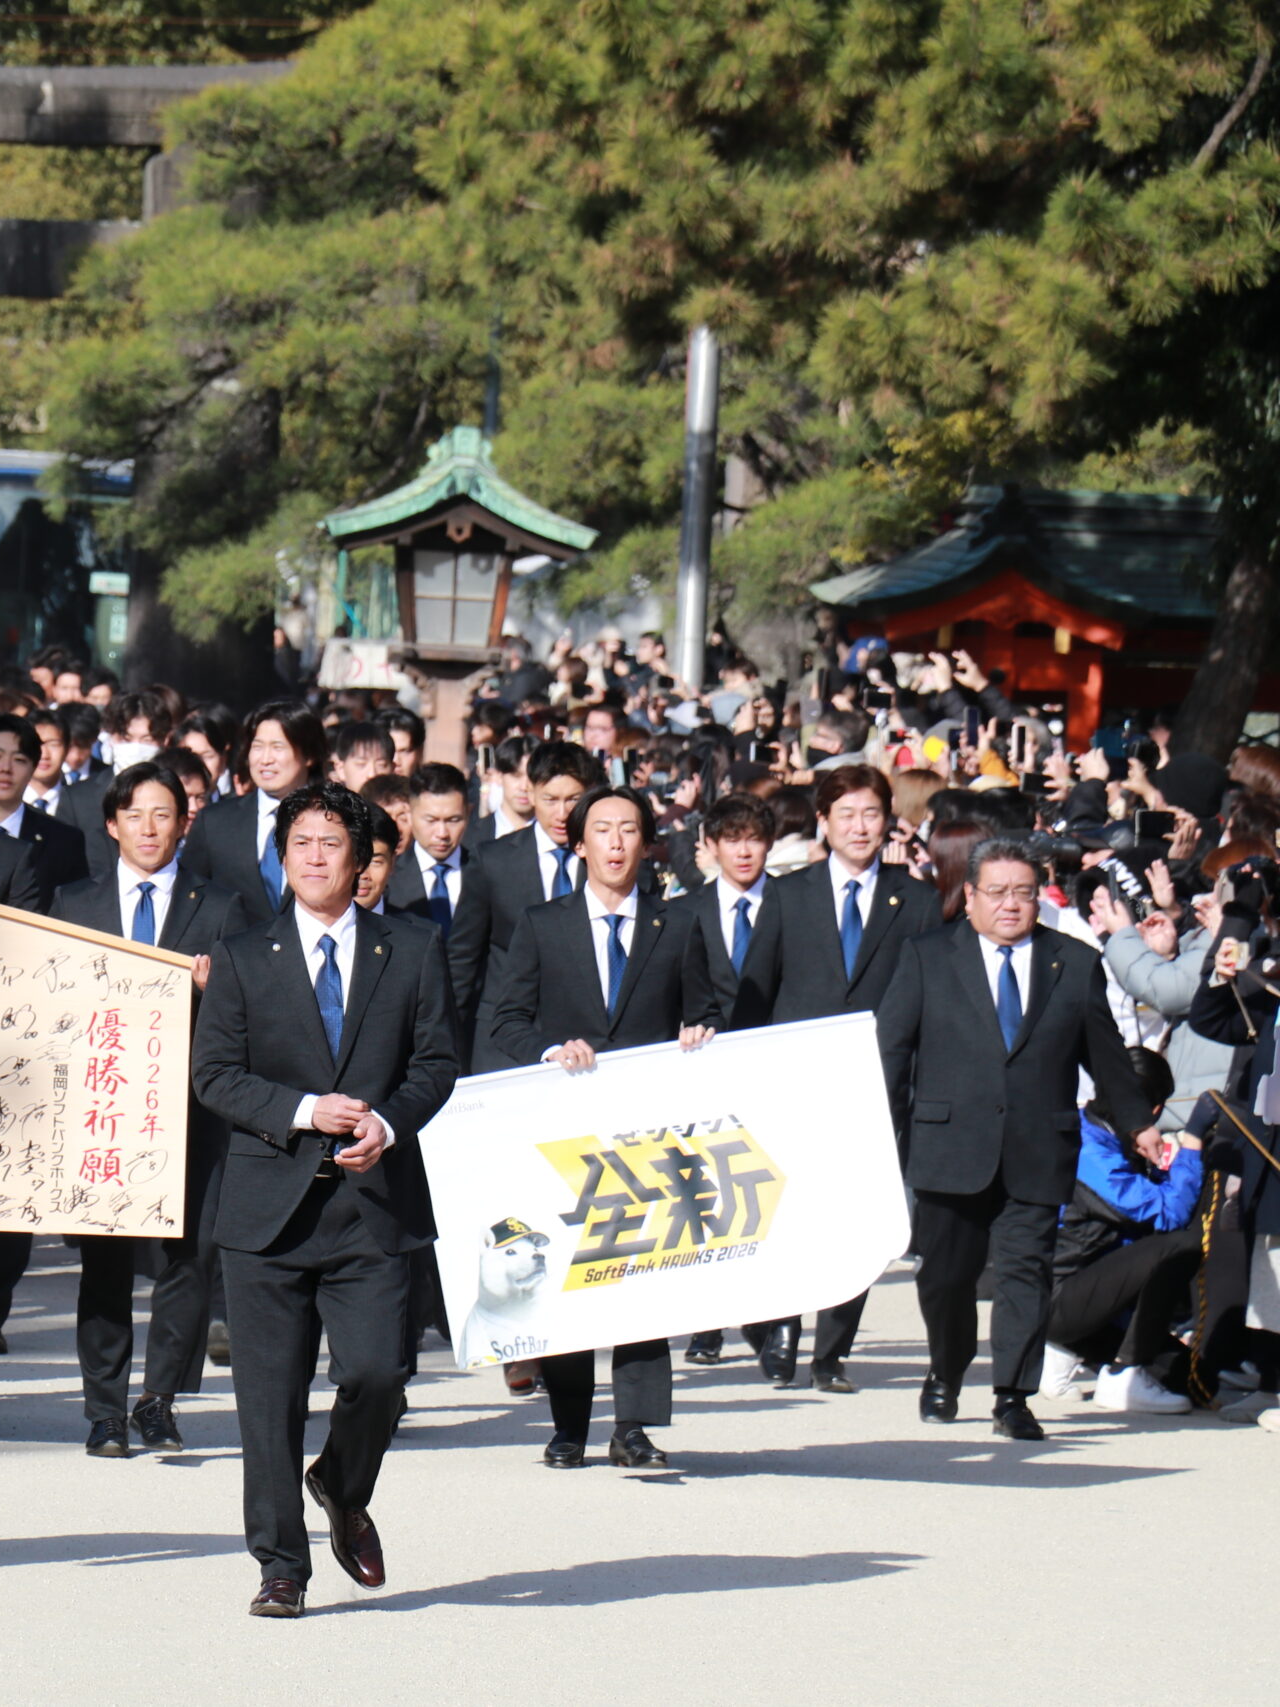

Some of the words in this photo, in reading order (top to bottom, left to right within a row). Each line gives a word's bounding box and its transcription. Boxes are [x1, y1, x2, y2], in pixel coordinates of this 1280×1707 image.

[48, 1063, 69, 1214] 福岡ソフトバンクホークス
[78, 1007, 129, 1187] 優勝祈願
[139, 1009, 165, 1142] 2026年
[558, 1140, 777, 1266] 全新
[584, 1258, 654, 1283] SoftBank
[658, 1249, 715, 1271] HAWKS
[716, 1241, 759, 1262] 2026
